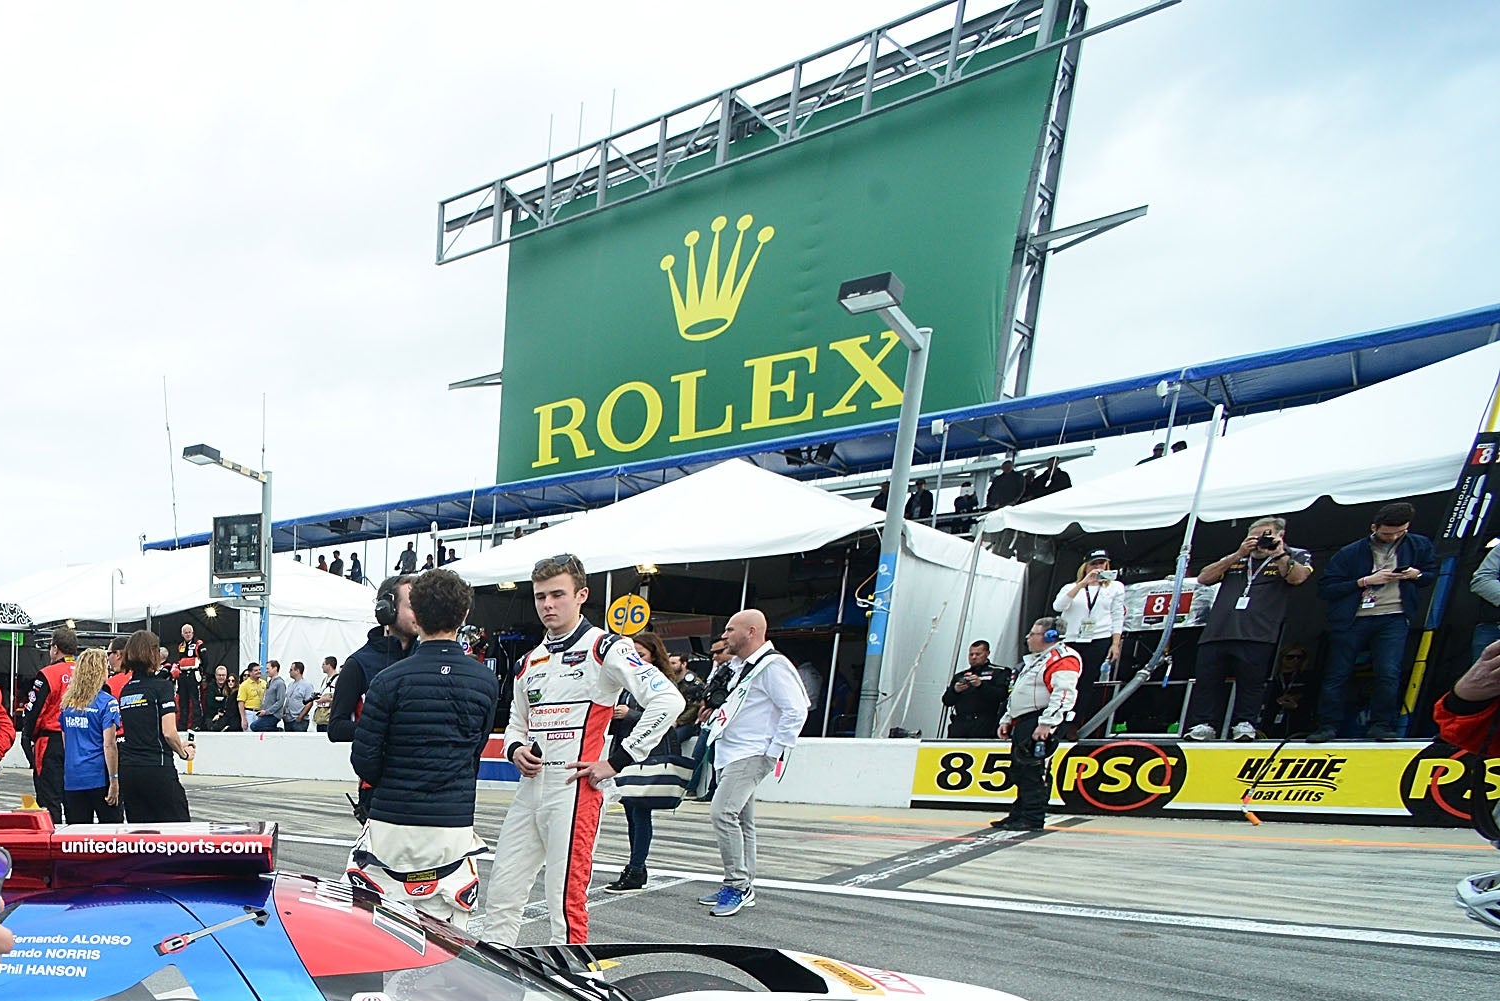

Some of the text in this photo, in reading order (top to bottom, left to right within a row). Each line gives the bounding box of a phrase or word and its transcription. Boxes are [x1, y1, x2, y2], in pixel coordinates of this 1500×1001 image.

[531, 331, 906, 468] ROLEX
[1443, 476, 1472, 539] MOTORSPORTS
[1457, 494, 1471, 520] MILLER
[613, 604, 645, 627] 96
[651, 711, 668, 730] MILLE
[548, 732, 574, 740] MOTUL
[1062, 756, 1179, 794] PSC
[1408, 757, 1500, 801] PS
[1284, 789, 1325, 802] Lifts
[61, 837, 263, 857] unitedautosports.com
[71, 934, 132, 946] ALONSO
[45, 948, 101, 961] NORRIS
[25, 964, 88, 978] HANSON
